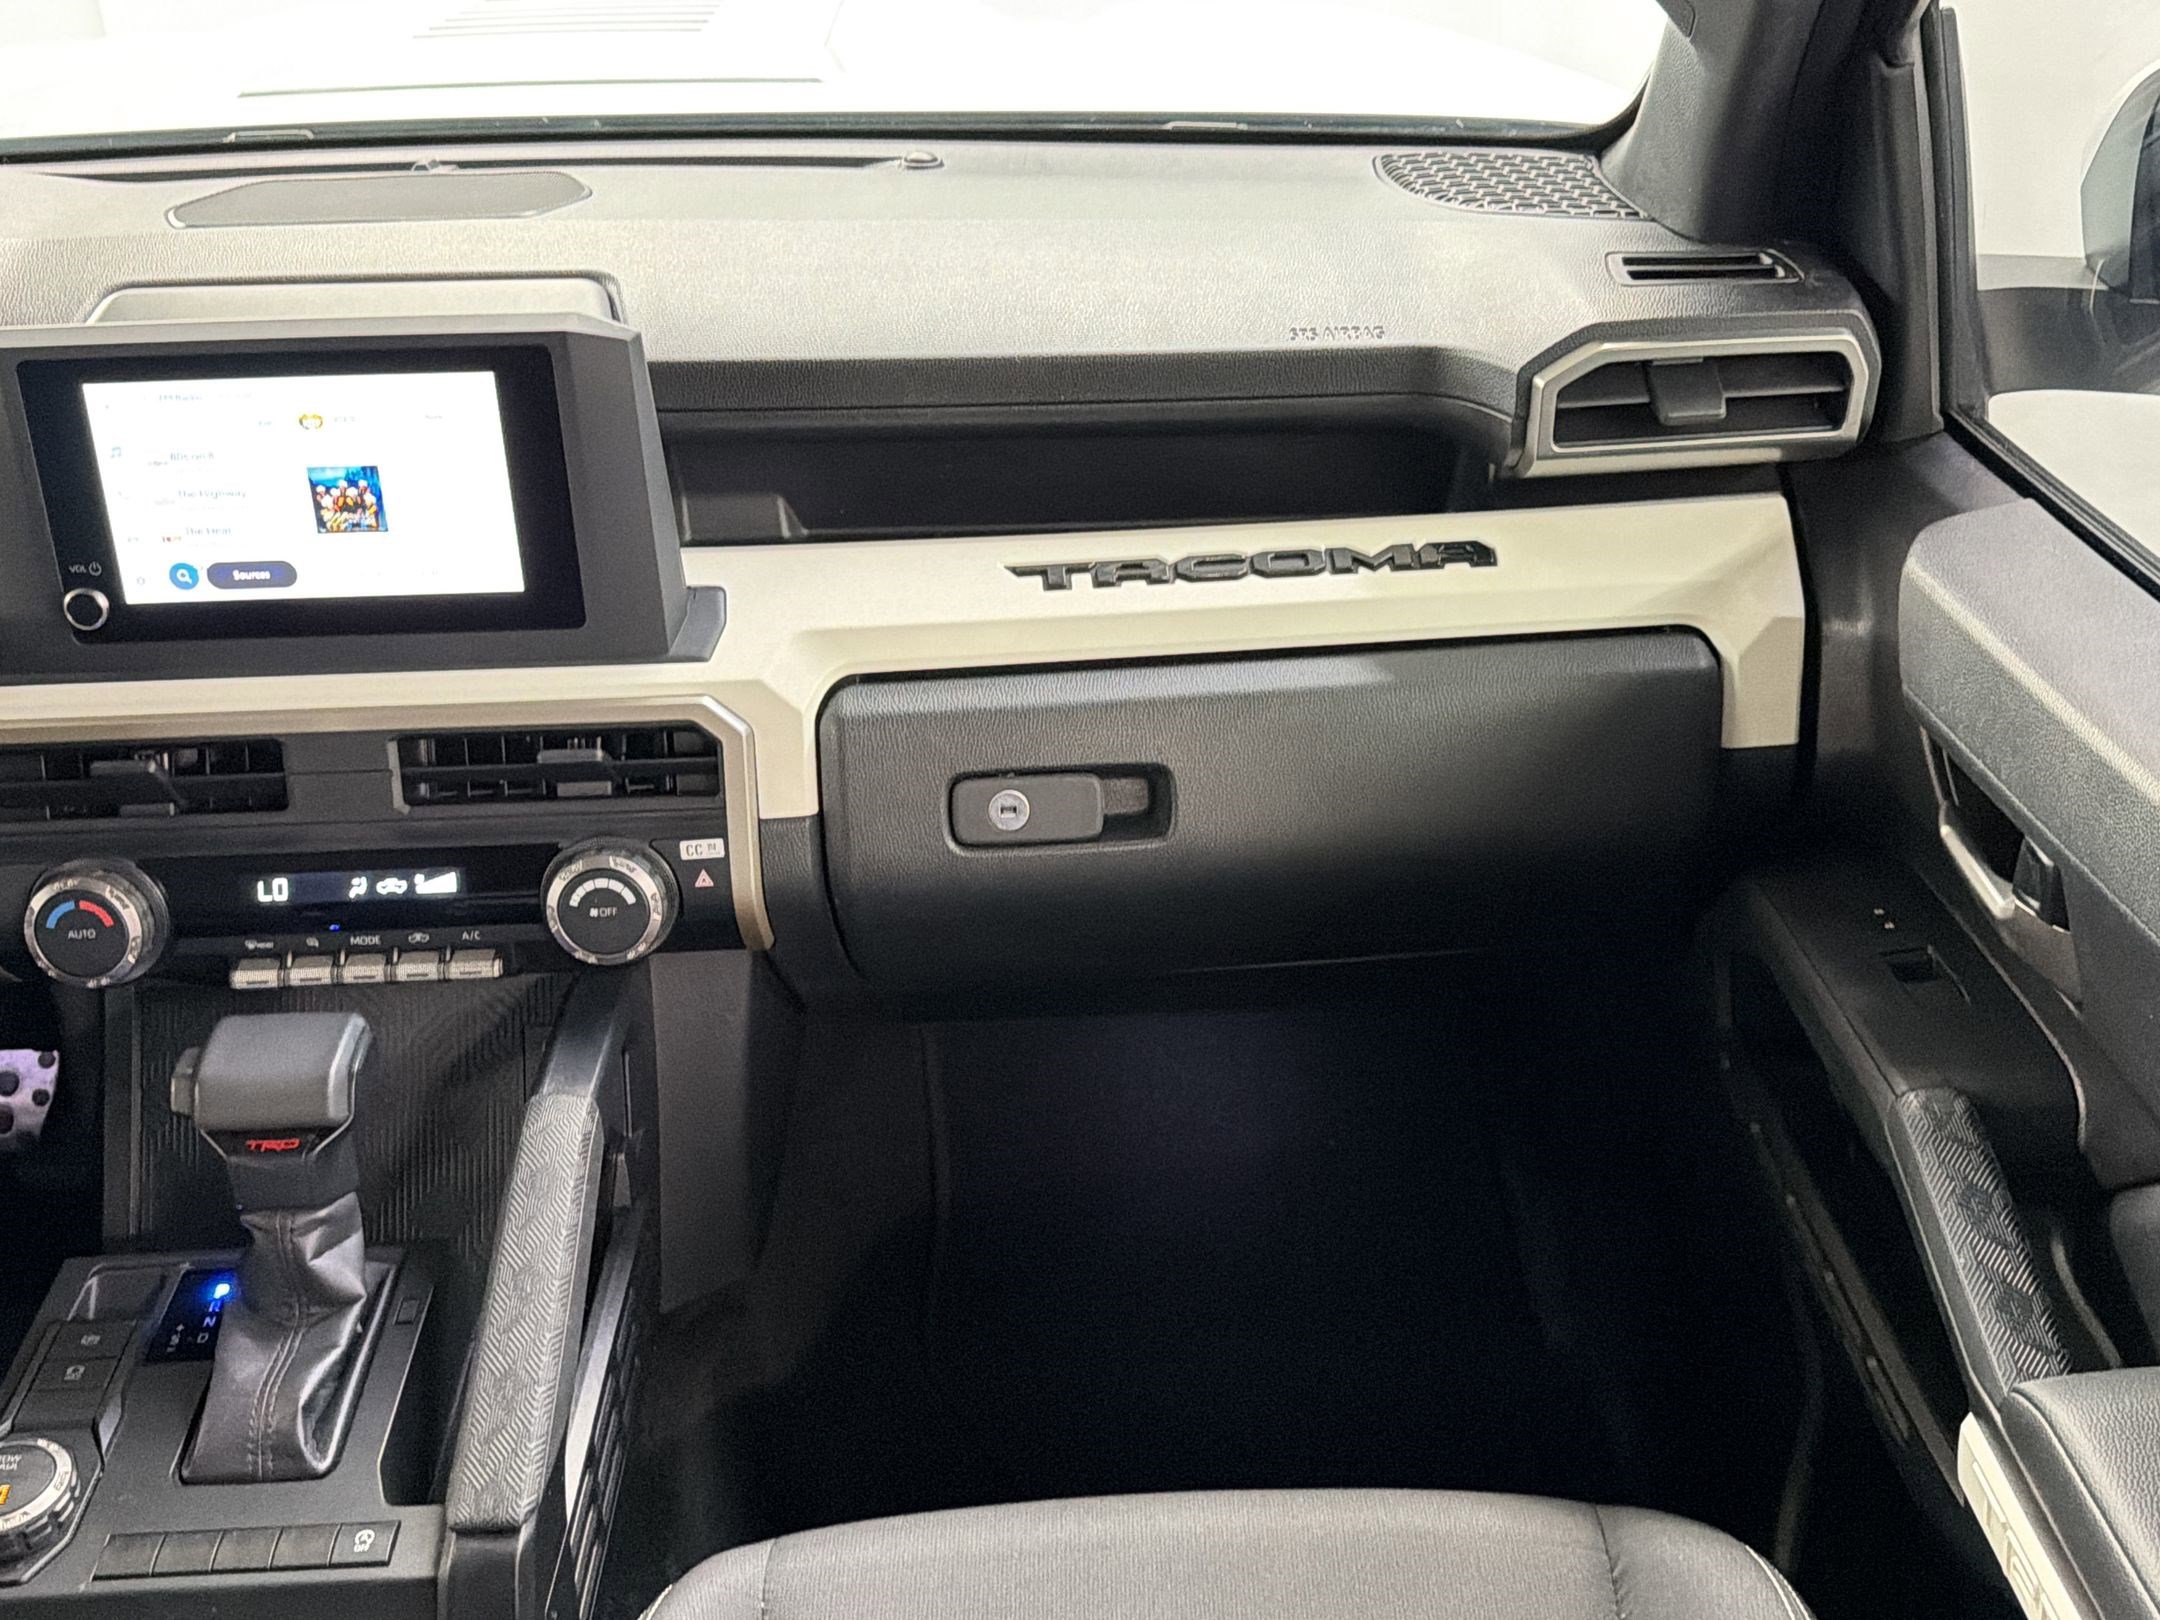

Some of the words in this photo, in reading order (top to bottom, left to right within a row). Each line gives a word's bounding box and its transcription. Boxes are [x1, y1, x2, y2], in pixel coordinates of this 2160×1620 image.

[1322, 325, 1386, 341] AIRBAG
[68, 564, 88, 574] VOL
[1003, 539, 1499, 592] TACOMA
[232, 568, 272, 582] Sources
[257, 877, 290, 902] LO
[599, 906, 618, 917] OFF
[67, 928, 97, 940] AUTO
[350, 934, 383, 946] MODE
[461, 930, 481, 941] A/C
[245, 1138, 301, 1152] TRD
[202, 1315, 217, 1328] N
[196, 1332, 210, 1344] D
